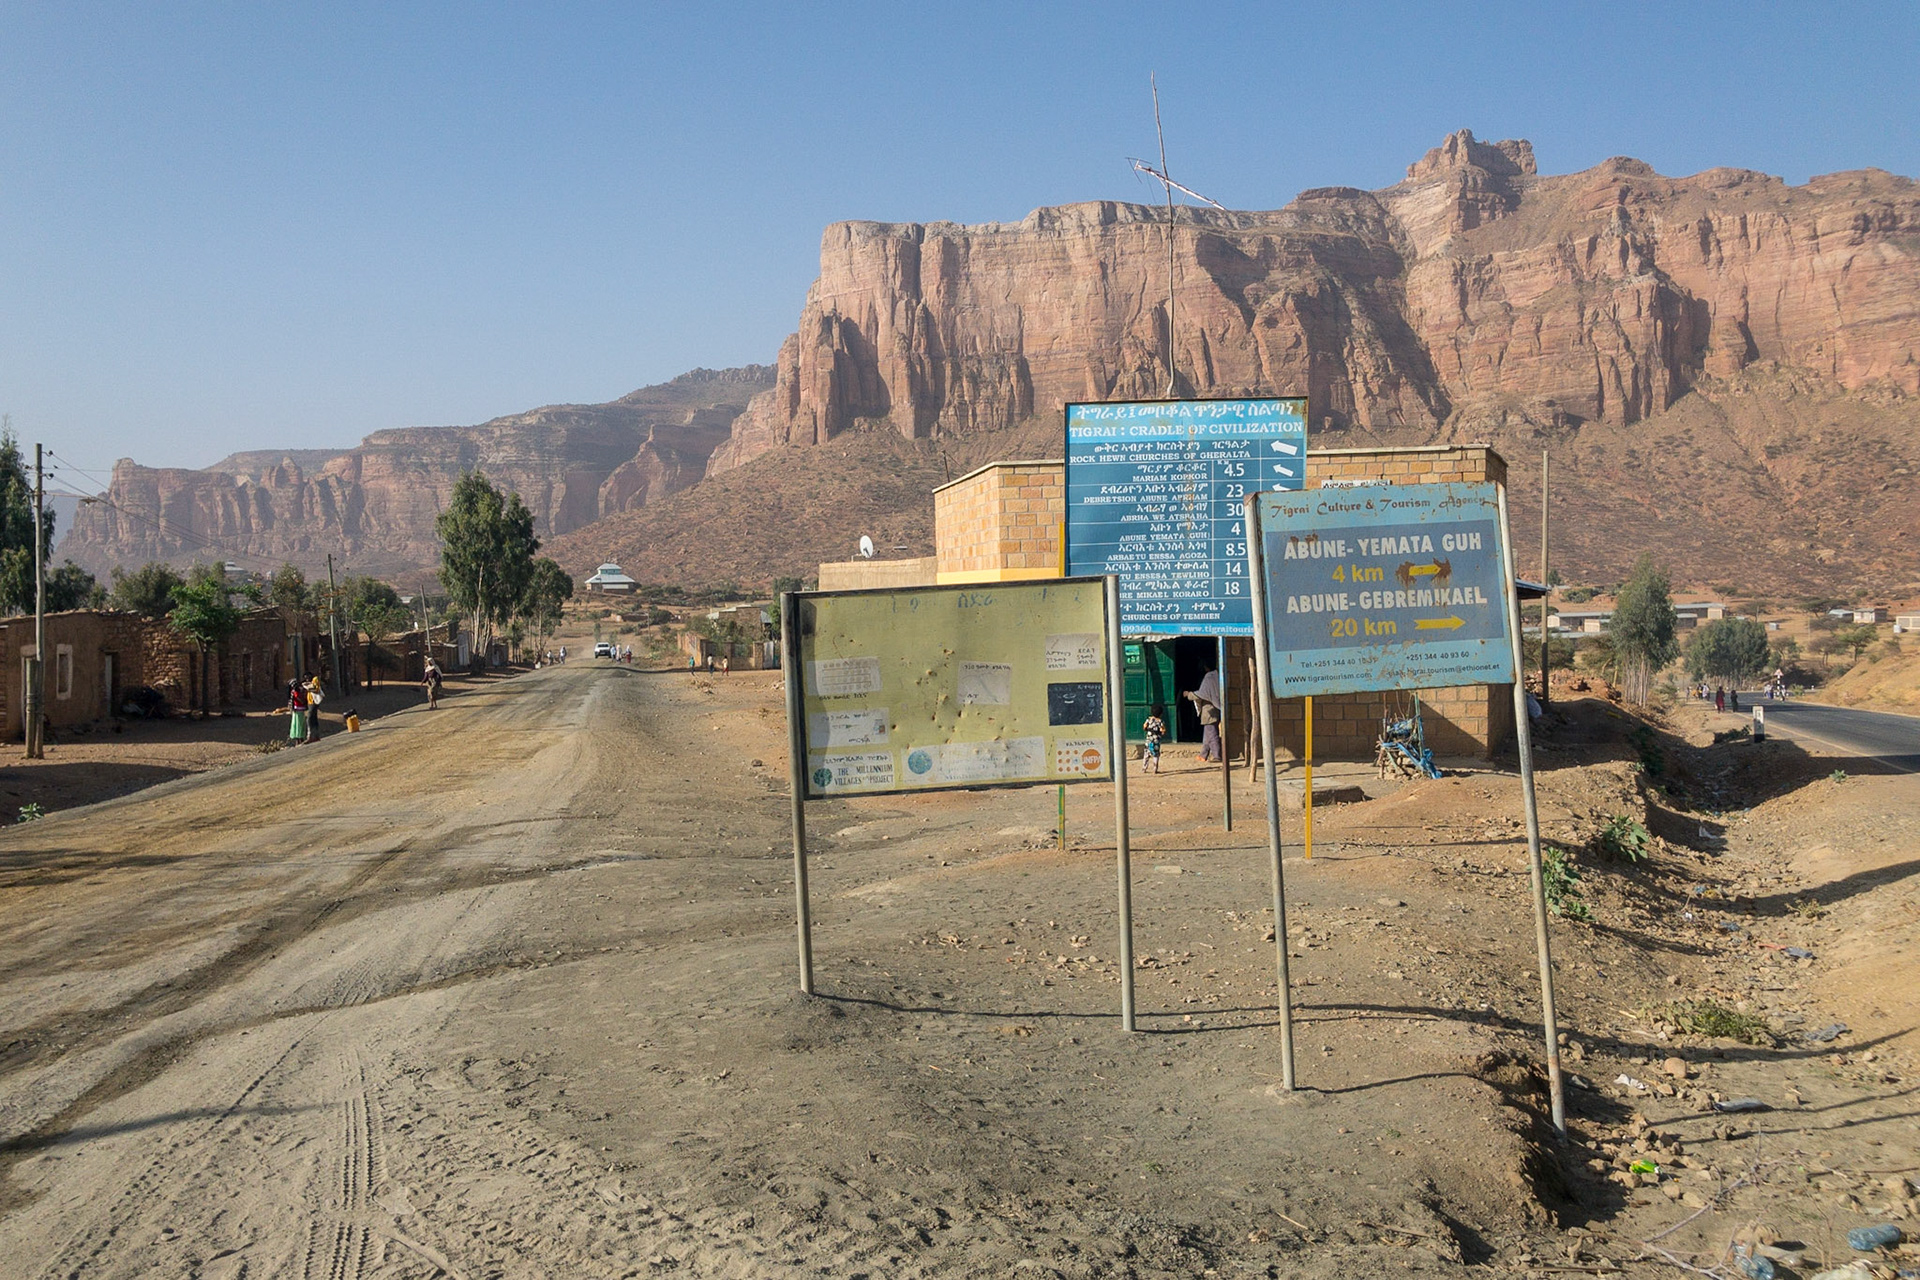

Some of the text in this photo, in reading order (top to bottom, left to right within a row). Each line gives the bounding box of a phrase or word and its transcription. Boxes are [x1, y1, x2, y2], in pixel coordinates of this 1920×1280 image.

[1070, 427, 1117, 438] TIGRAI
[1130, 425, 1184, 437] CRADLE
[1189, 424, 1207, 435] OF
[1208, 422, 1303, 435] CIVILIZATION
[1070, 455, 1095, 463] ROCK
[1100, 454, 1126, 462] HEWN
[1129, 453, 1179, 461] CHURCHES
[1200, 451, 1251, 460] GHERALTA
[1224, 463, 1245, 477] 4.5
[1133, 474, 1168, 482] MARIAM
[1226, 484, 1244, 498] 23
[1084, 496, 1138, 504] DEBRETSION
[1226, 503, 1245, 517] 30
[1271, 505, 1310, 518] Tigrai
[1316, 501, 1361, 516] Culture
[1365, 499, 1375, 511] &
[1380, 498, 1431, 512] Tourism
[1121, 514, 1149, 522] ABRHA
[1231, 522, 1241, 536] 4
[1120, 534, 1147, 542] ABUNE
[1150, 533, 1185, 541] YEMATA
[1441, 532, 1482, 551] GUH
[1149, 552, 1176, 560] ENSSA
[1226, 543, 1247, 556] 8.5
[1225, 562, 1242, 575] 14
[1332, 564, 1384, 583] 4 km
[1134, 571, 1168, 580] ENSESA
[1136, 591, 1170, 599] MIKAEL
[1172, 590, 1210, 598] KORARO
[1224, 581, 1240, 595] 18
[1122, 612, 1221, 621] CHURCHES OF TEMBIEN
[1331, 617, 1397, 638] 20 km
[1425, 652, 1437, 660] 344
[1440, 652, 1449, 660] 40
[838, 763, 893, 776] THE MILLENNIUM
[834, 774, 893, 786] VILLAGES PROJECT
